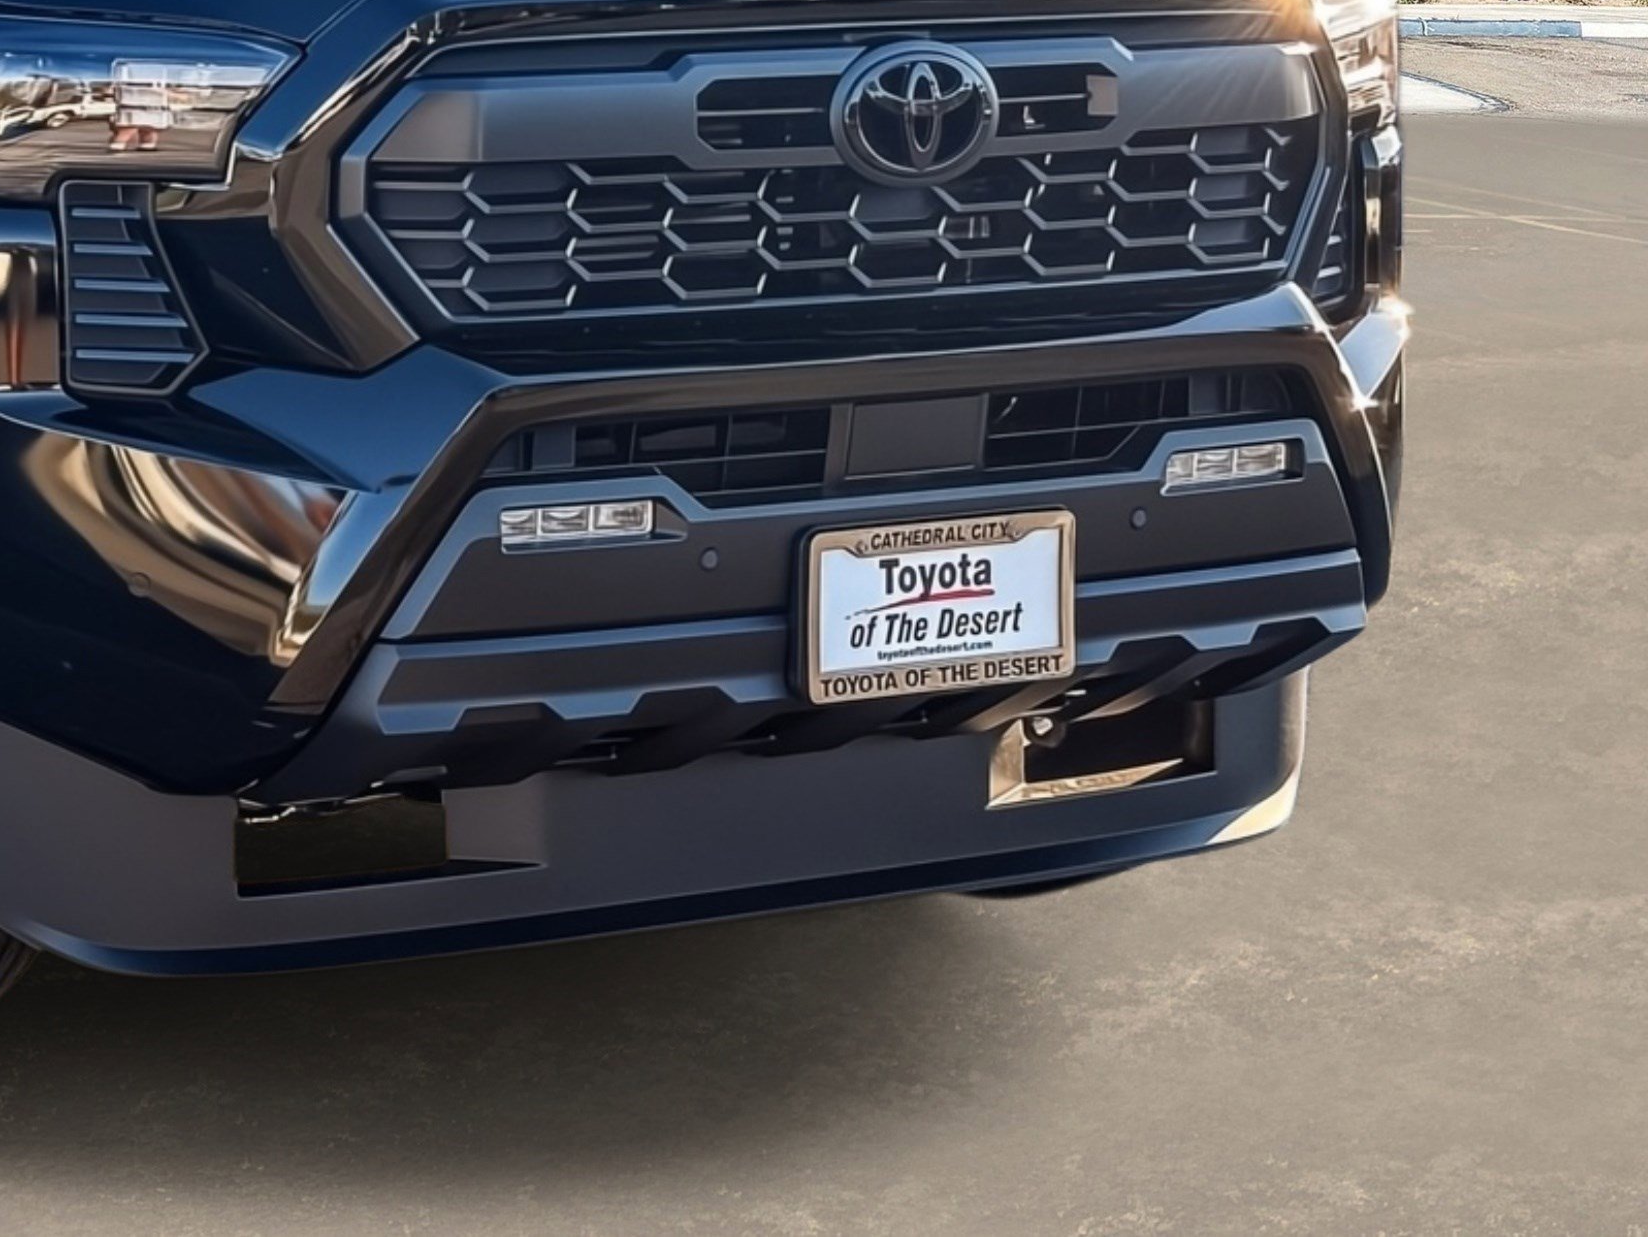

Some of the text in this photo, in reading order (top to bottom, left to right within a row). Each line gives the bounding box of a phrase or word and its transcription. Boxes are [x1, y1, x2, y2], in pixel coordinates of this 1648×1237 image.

[870, 521, 1011, 551] CATHEDRAL CITY
[879, 554, 993, 598] Toyota
[850, 602, 1024, 649] of The Desert
[820, 654, 1065, 698] TOYOTA OF THE DESERT
